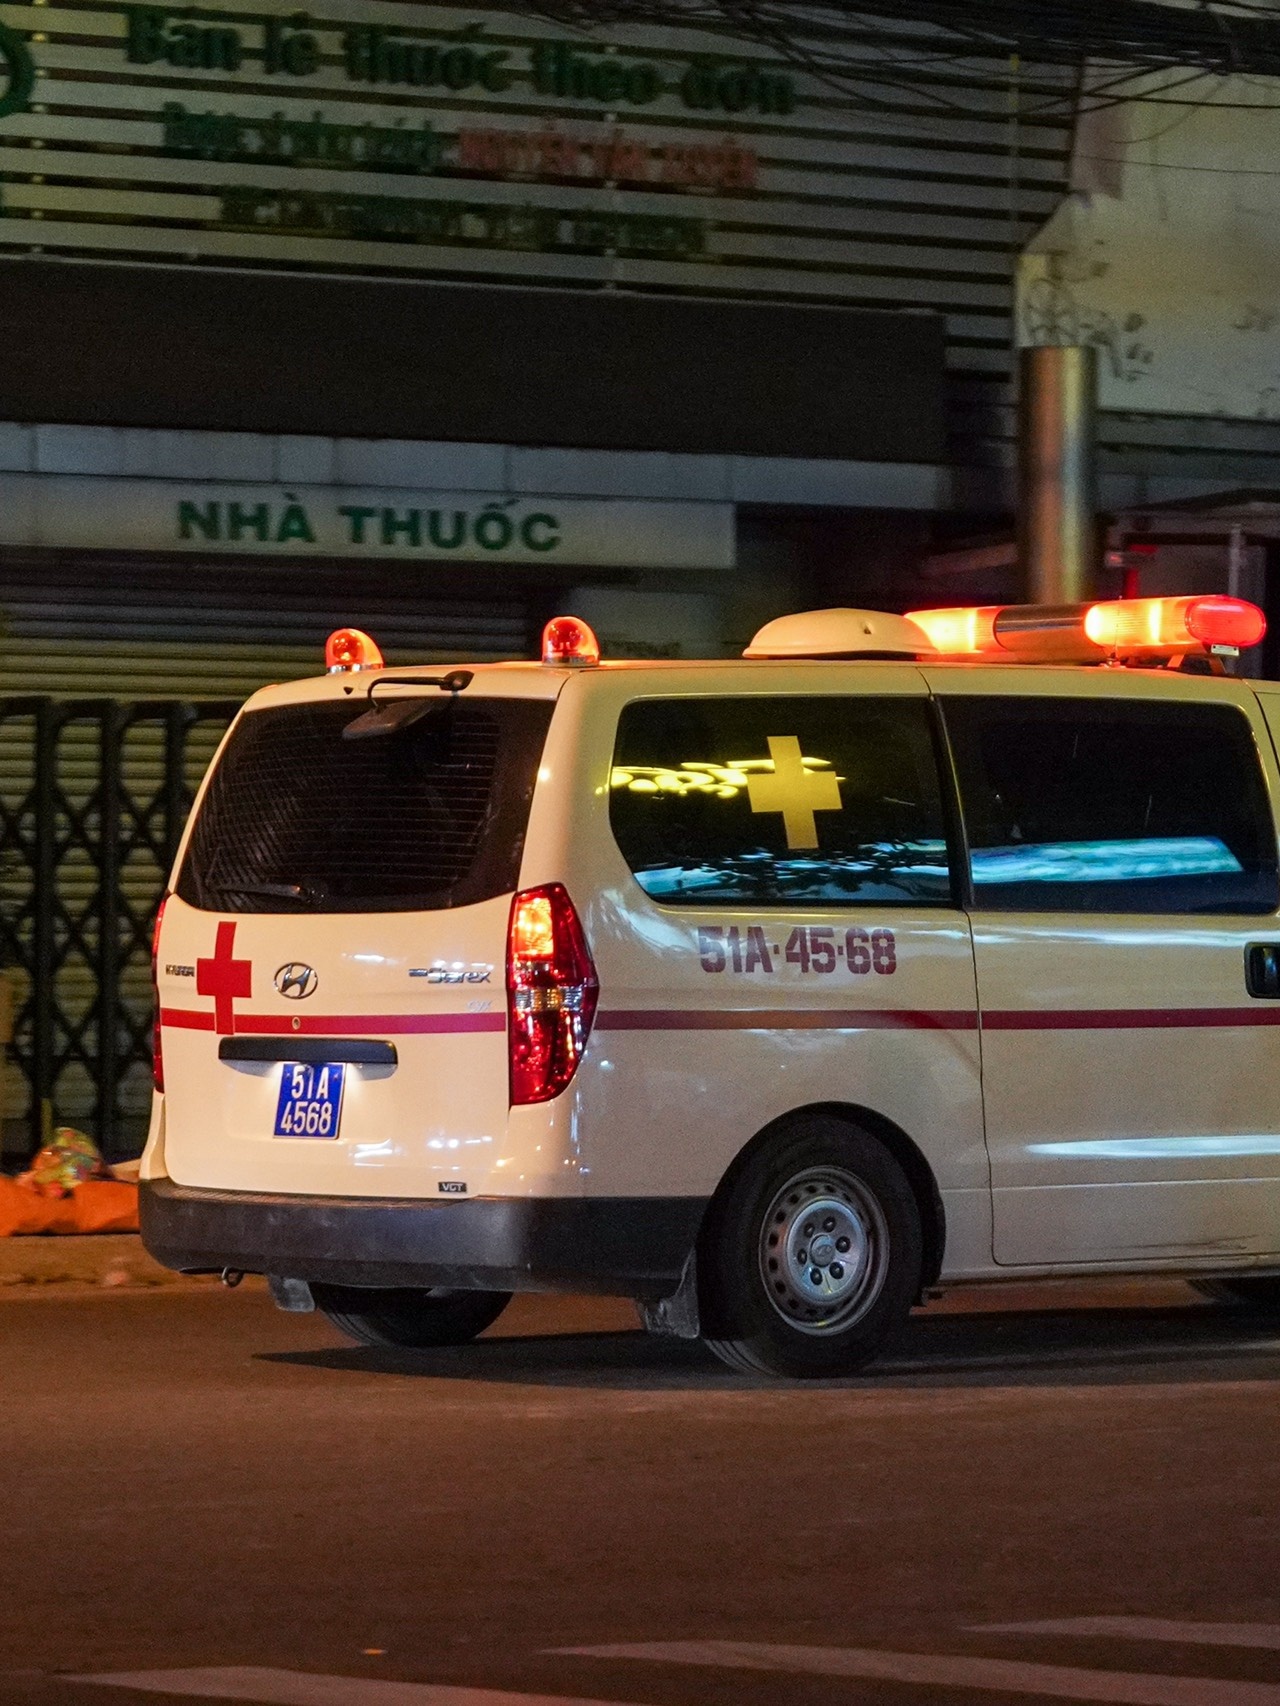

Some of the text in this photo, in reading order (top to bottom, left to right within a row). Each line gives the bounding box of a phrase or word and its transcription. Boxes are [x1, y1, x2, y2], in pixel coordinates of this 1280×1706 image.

[343, 22, 512, 93] thuốc
[530, 38, 660, 106] theo
[177, 492, 562, 553] NHÀ THUỐC
[290, 1064, 330, 1099] 51A
[280, 1100, 333, 1136] 4568
